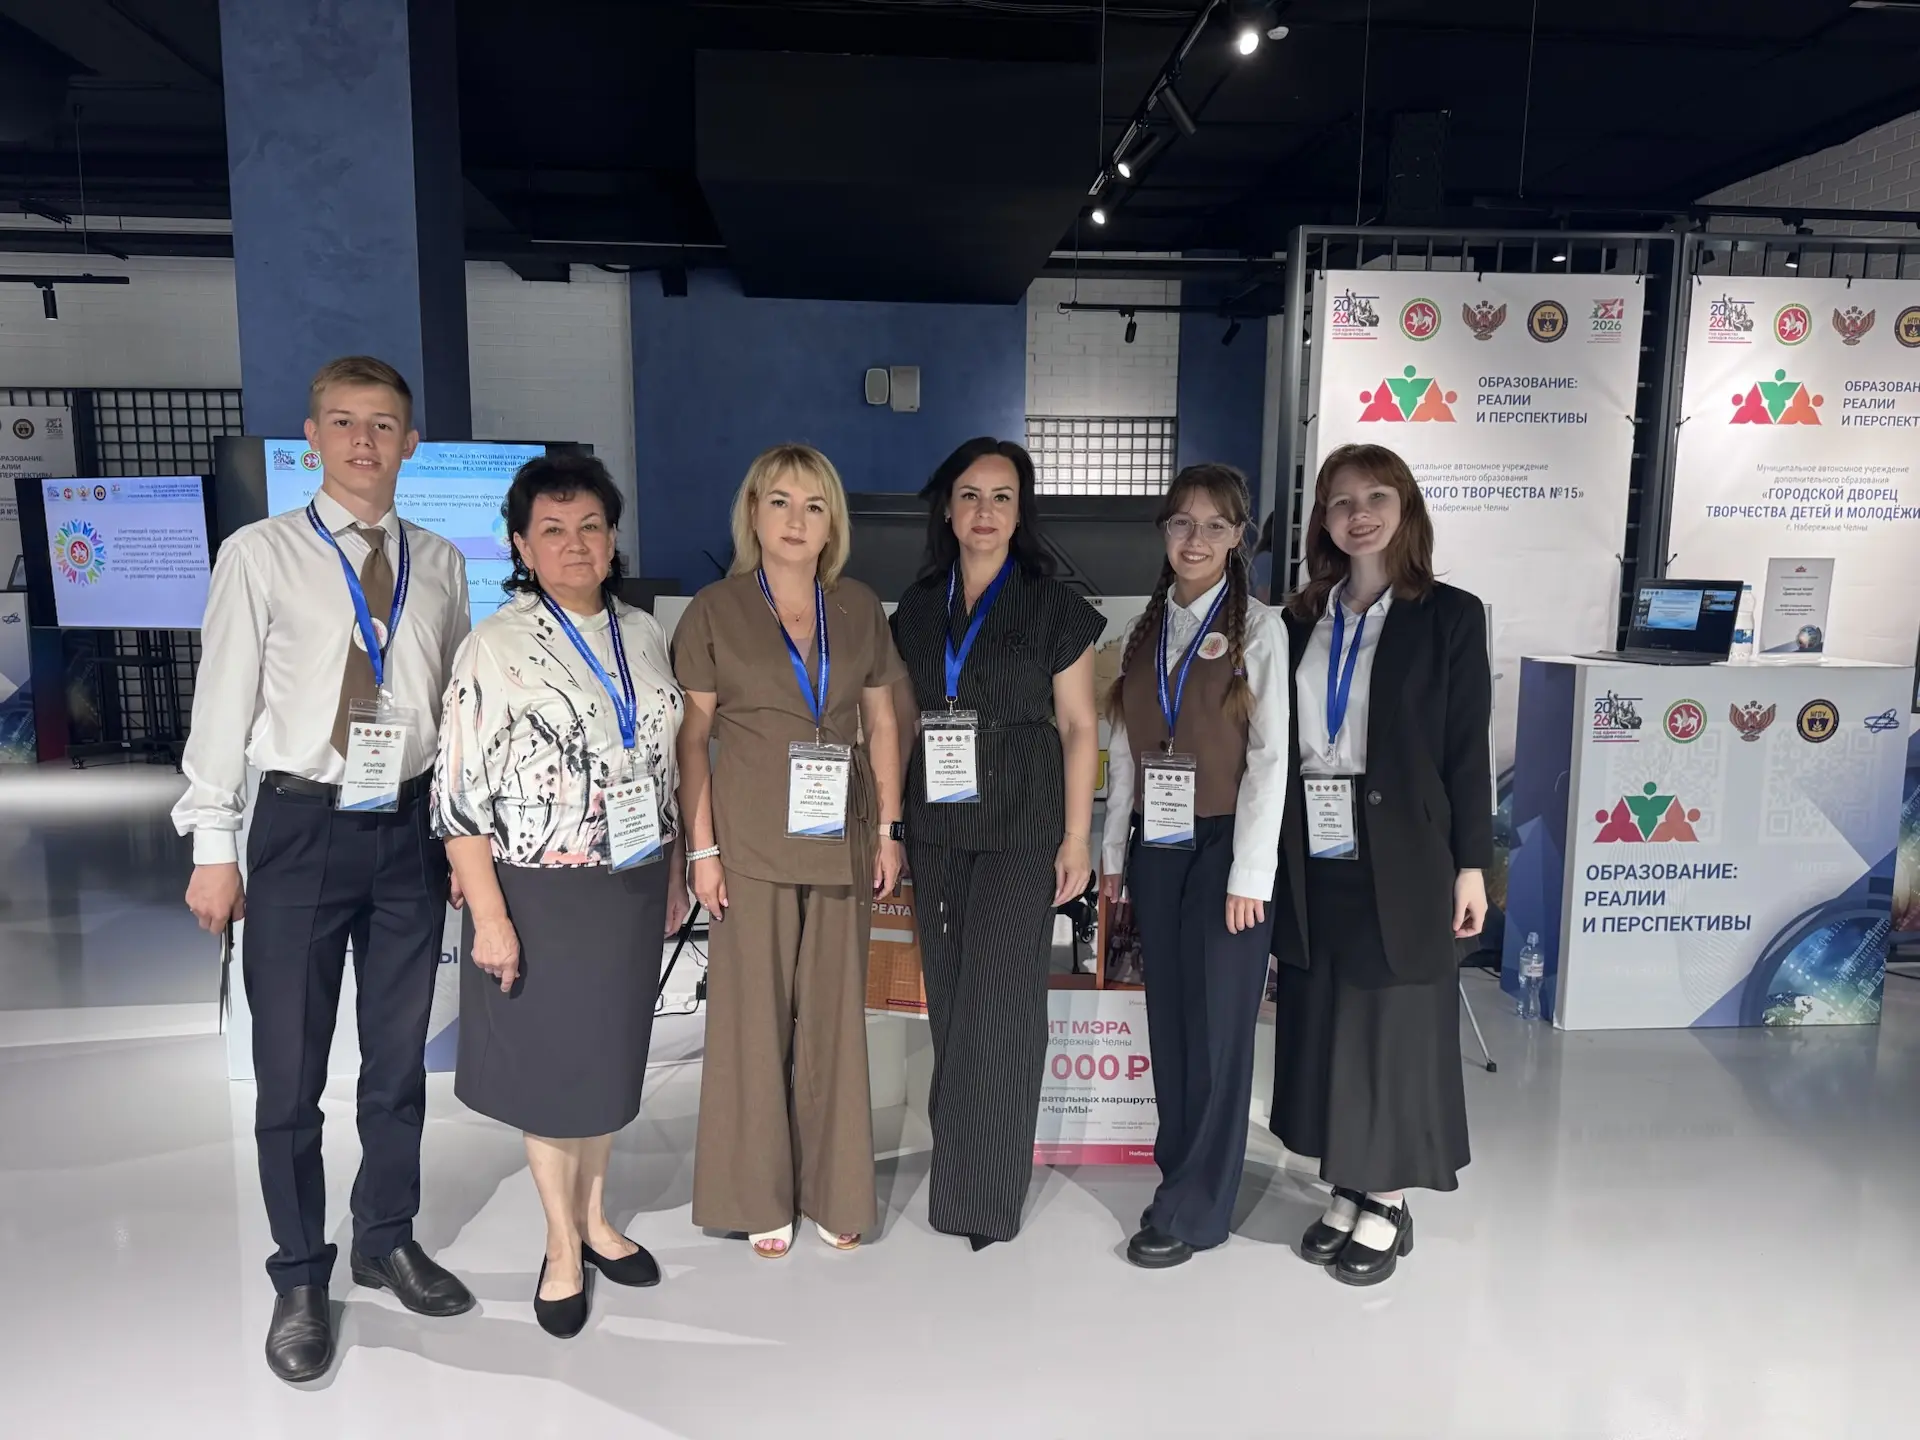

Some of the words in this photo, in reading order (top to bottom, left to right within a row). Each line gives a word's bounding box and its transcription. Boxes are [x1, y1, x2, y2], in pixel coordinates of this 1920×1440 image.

[1592, 320, 1622, 330] 2026
[1478, 376, 1578, 389] ОБРАЗОВАНИЕ:
[1477, 394, 1531, 406] РЕАЛИИ
[1843, 398, 1895, 410] РЕАЛИИ
[1476, 412, 1485, 423] И
[1489, 412, 1587, 424] ПЕРСПЕКТИВЫ
[1842, 416, 1850, 426] И
[1854, 416, 1920, 427] ПЕРСПЕКТ
[1410, 463, 1452, 471] ципальное
[1502, 464, 1549, 473] учреждение
[1757, 464, 1816, 473] Муниципальное
[1864, 465, 1909, 474] учреждение
[1416, 474, 1477, 482] ополнительного
[1478, 474, 1528, 482] образования
[1774, 476, 1839, 484] дополнительного
[1841, 476, 1889, 484] образования
[1462, 486, 1545, 499] ТВОРЧЕСТВА
[1550, 487, 1584, 498] №15»
[1762, 486, 1844, 502] «ГОРОДСКОЙ
[1847, 488, 1898, 502] ДВОРЕЦ
[1432, 504, 1482, 512] Набережные
[1706, 506, 1787, 518] ТВОРЧЕСТВА
[1790, 504, 1831, 520] ДЕТЕЙ
[1834, 507, 1843, 518] И
[1847, 504, 1920, 521] МОЛОДЁЖИ
[1794, 523, 1841, 532] Набережные
[1586, 863, 1738, 881] ОБРАЗОВАНИЕ:
[1584, 891, 1666, 907] РЕАЛИИ
[1582, 917, 1596, 932] И
[1602, 915, 1751, 933] ПЕРСПЕКТИВЫ
[1072, 1021, 1132, 1034] МЭРА
[1102, 1038, 1132, 1047] Челны
